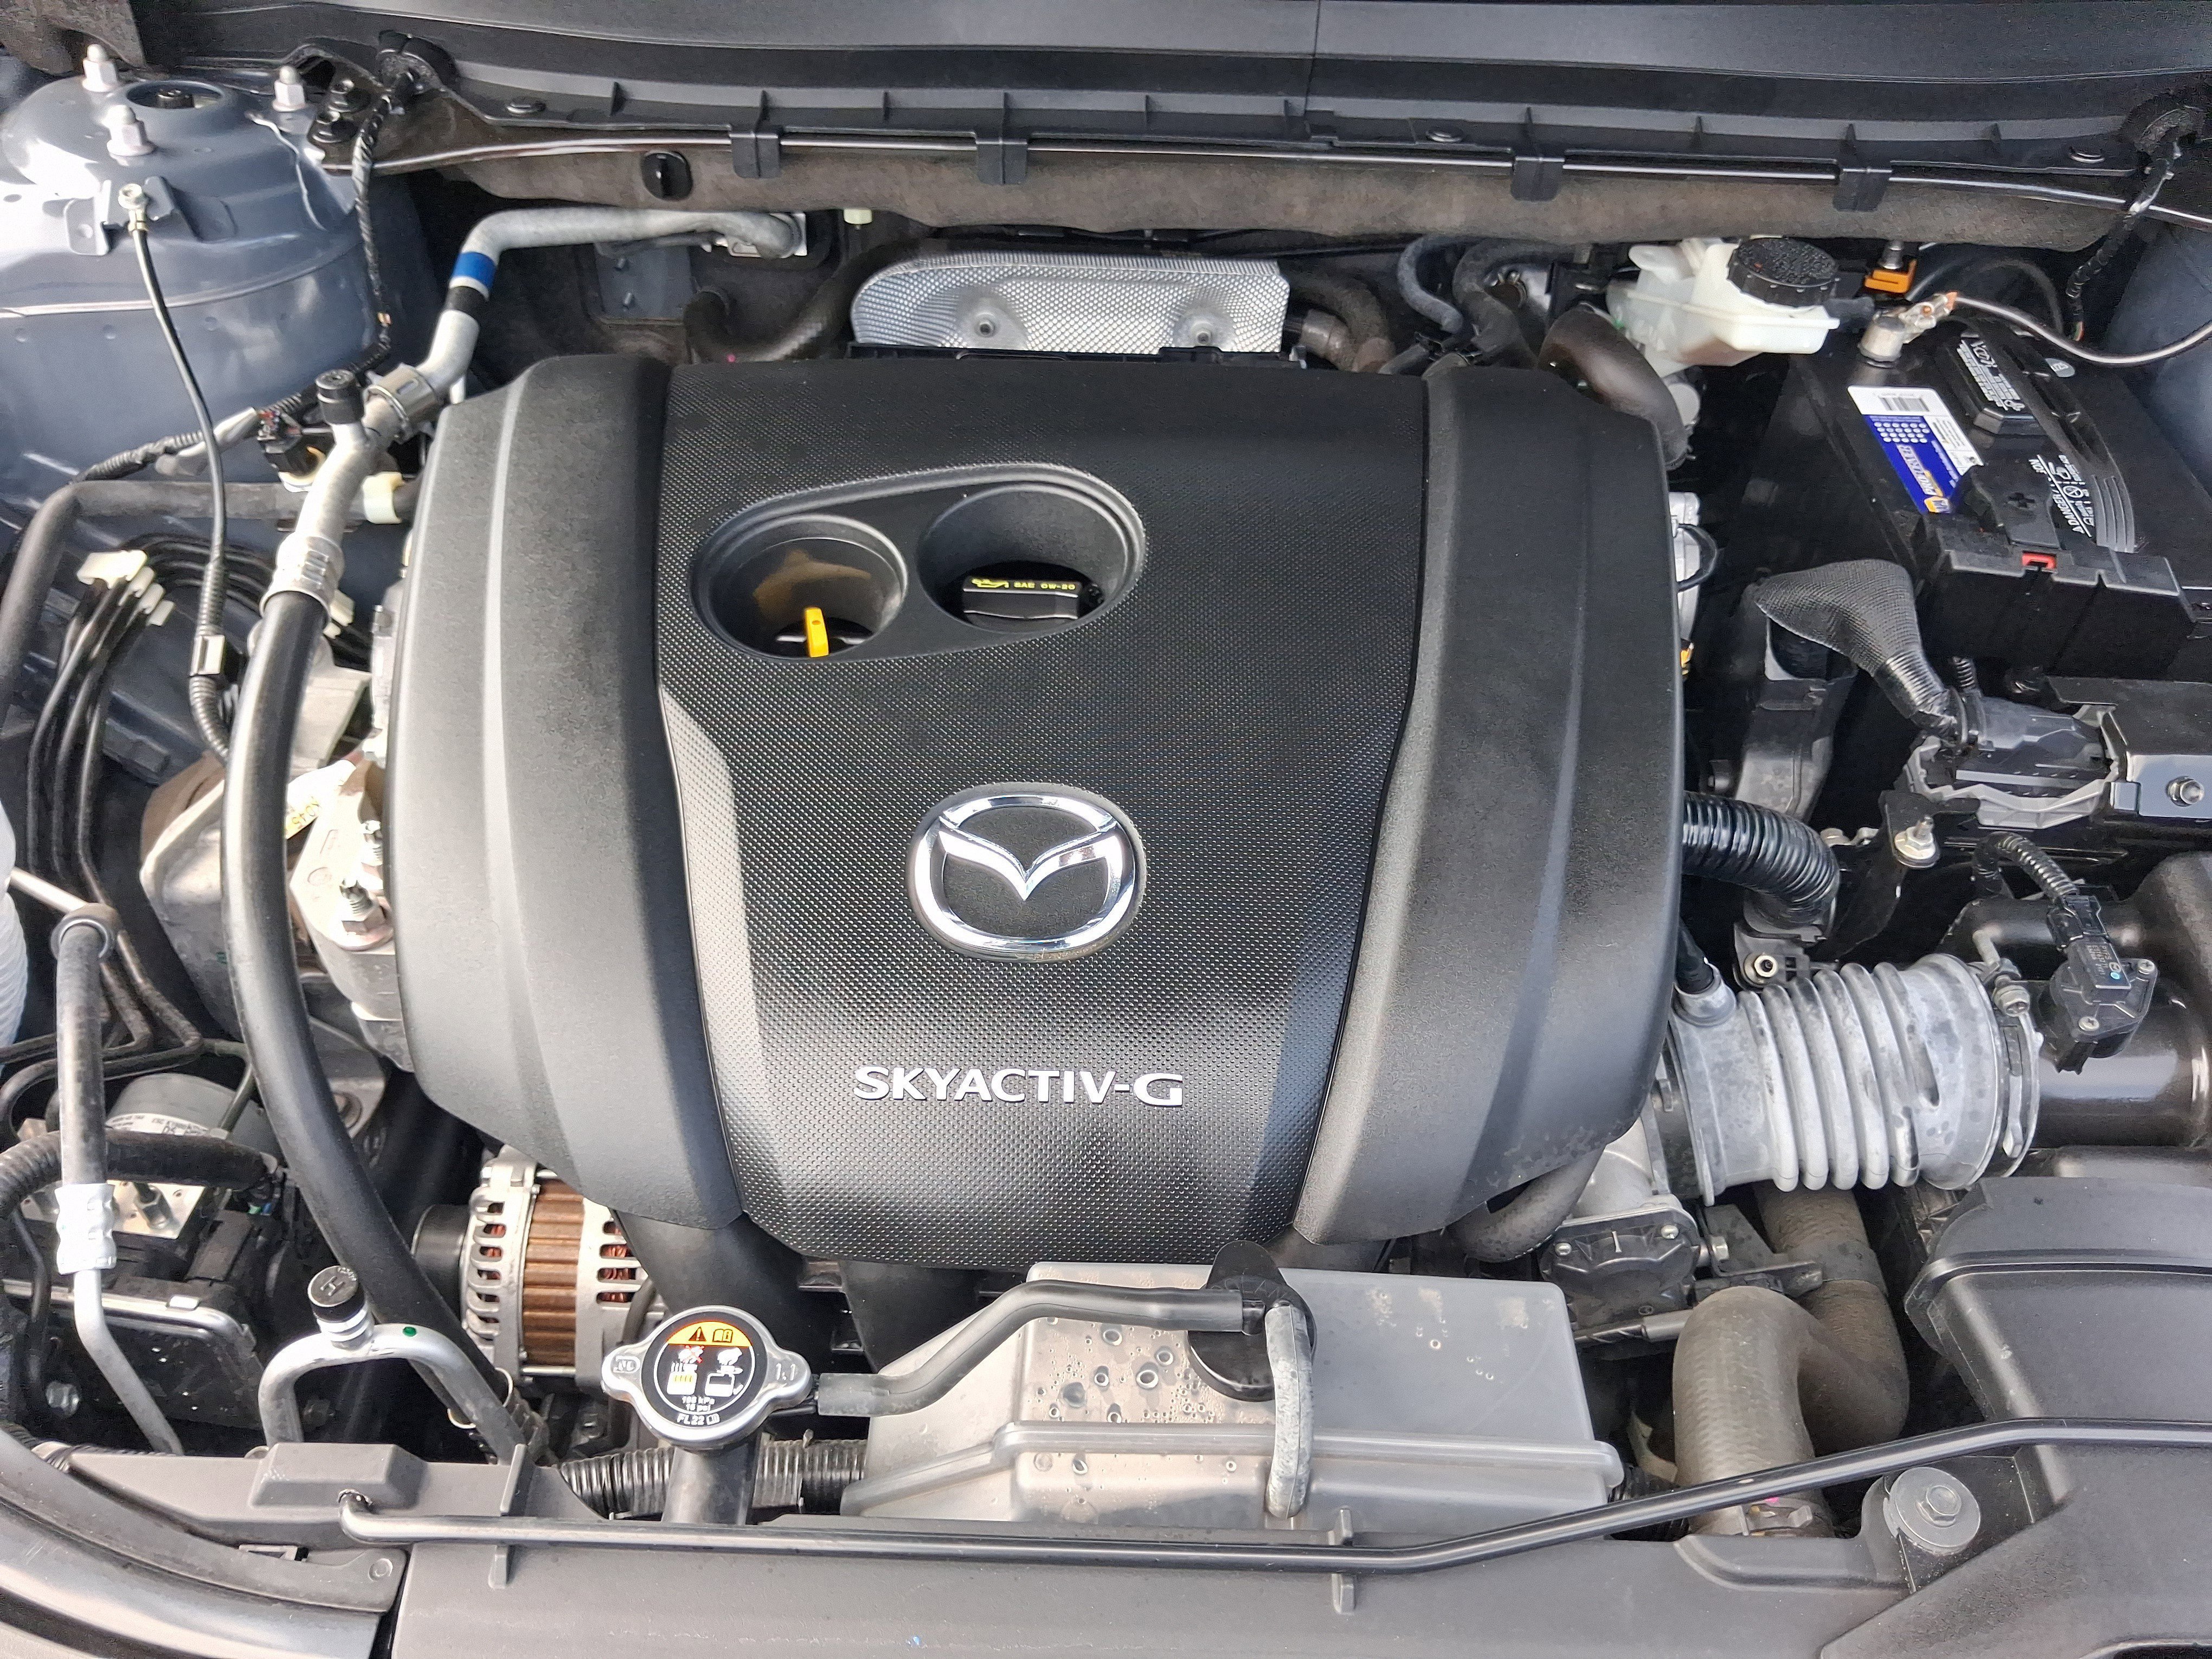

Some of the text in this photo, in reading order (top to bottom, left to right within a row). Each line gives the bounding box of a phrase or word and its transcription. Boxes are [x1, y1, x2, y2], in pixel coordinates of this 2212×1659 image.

[853, 1065, 1184, 1108] SKYACTIV-G
[320, 1275, 345, 1296] H
[677, 1413, 705, 1425] FL22
